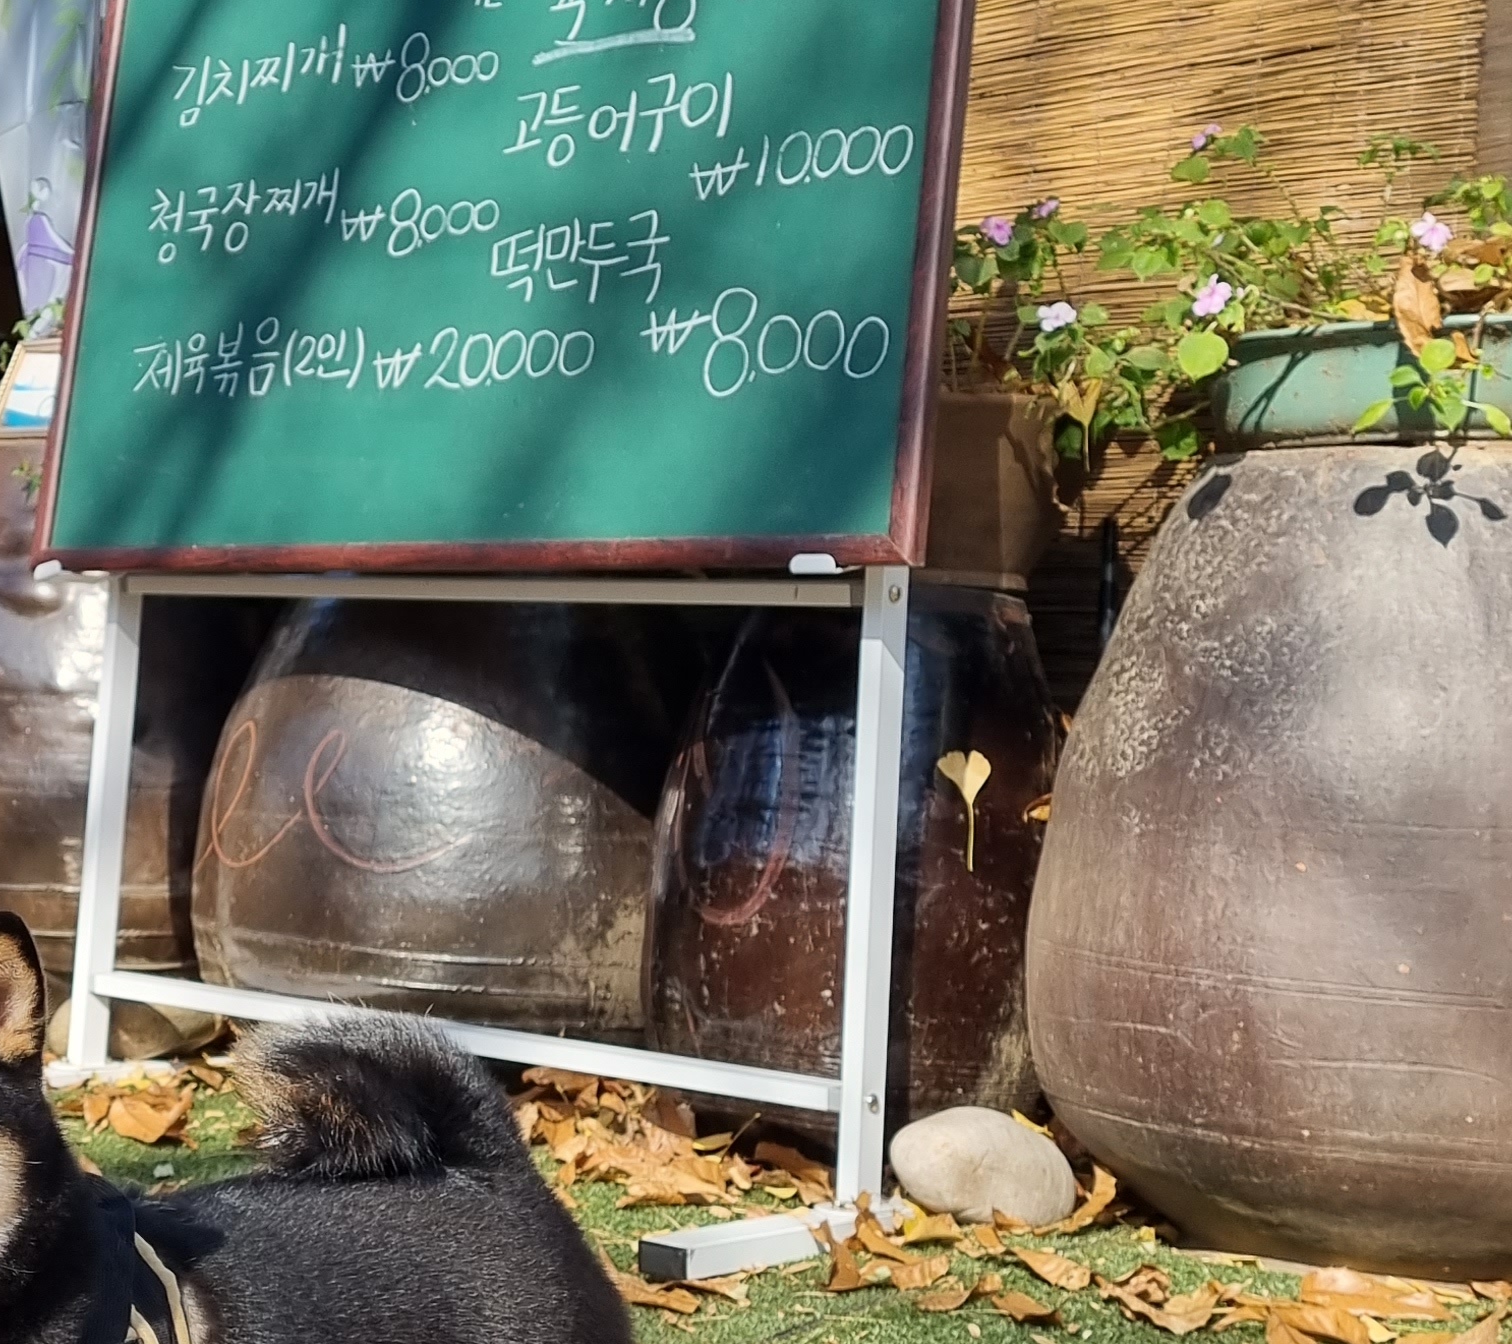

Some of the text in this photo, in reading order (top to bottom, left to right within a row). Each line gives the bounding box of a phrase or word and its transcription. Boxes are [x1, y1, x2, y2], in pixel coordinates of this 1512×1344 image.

[172, 22, 347, 127] 김치찌개
[501, 70, 734, 169] 고등어구이
[489, 208, 671, 305] 떡만두국
